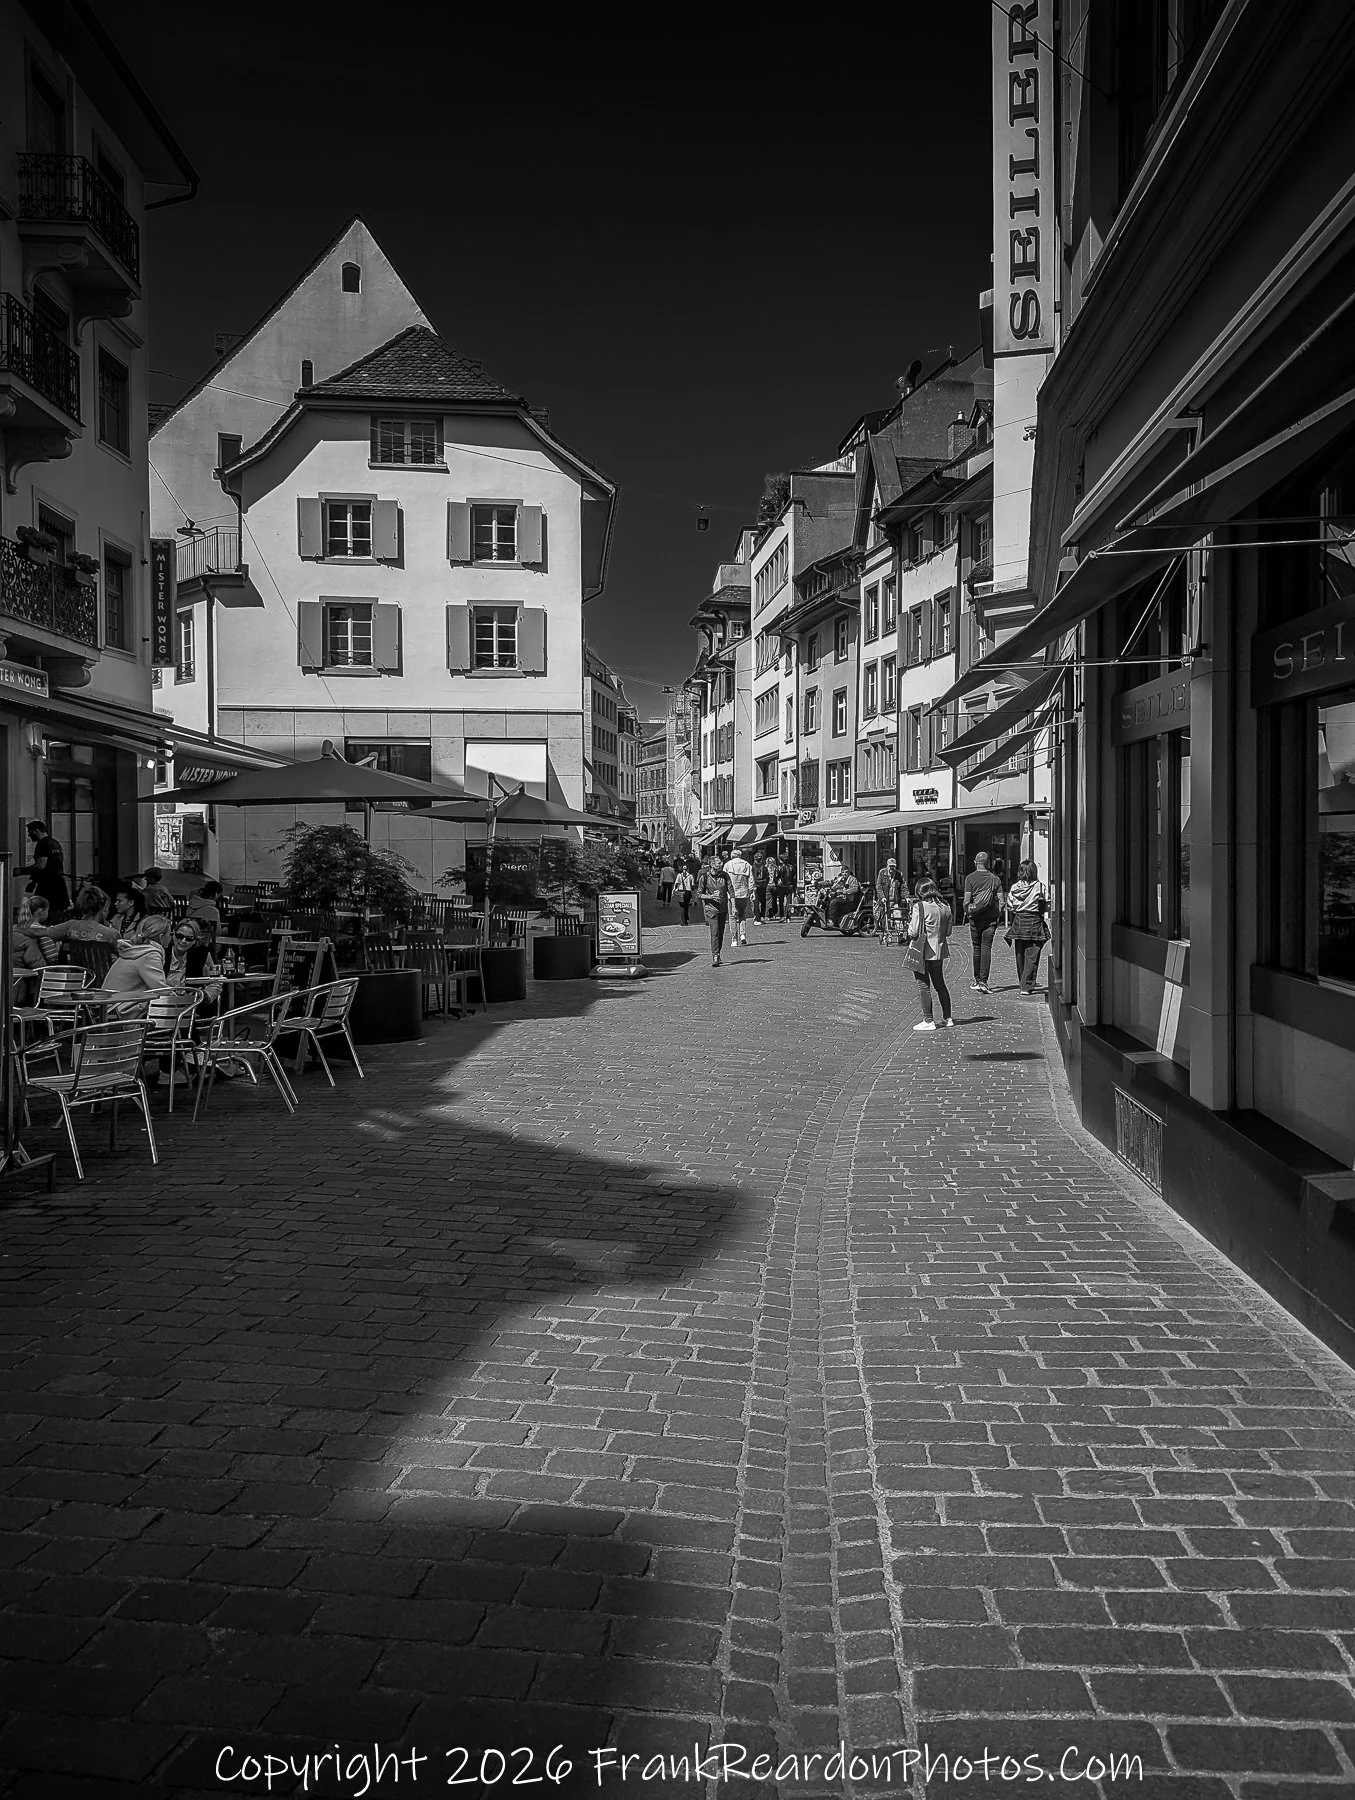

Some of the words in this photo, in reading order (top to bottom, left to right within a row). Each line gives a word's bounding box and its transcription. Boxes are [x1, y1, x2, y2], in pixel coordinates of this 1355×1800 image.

[1009, 0, 1041, 341] SEILER
[156, 553, 166, 610] MISTER
[156, 615, 167, 654] WONG
[17, 672, 42, 690] WONG
[1121, 683, 1191, 729] SEILE
[178, 766, 214, 783] MISTER
